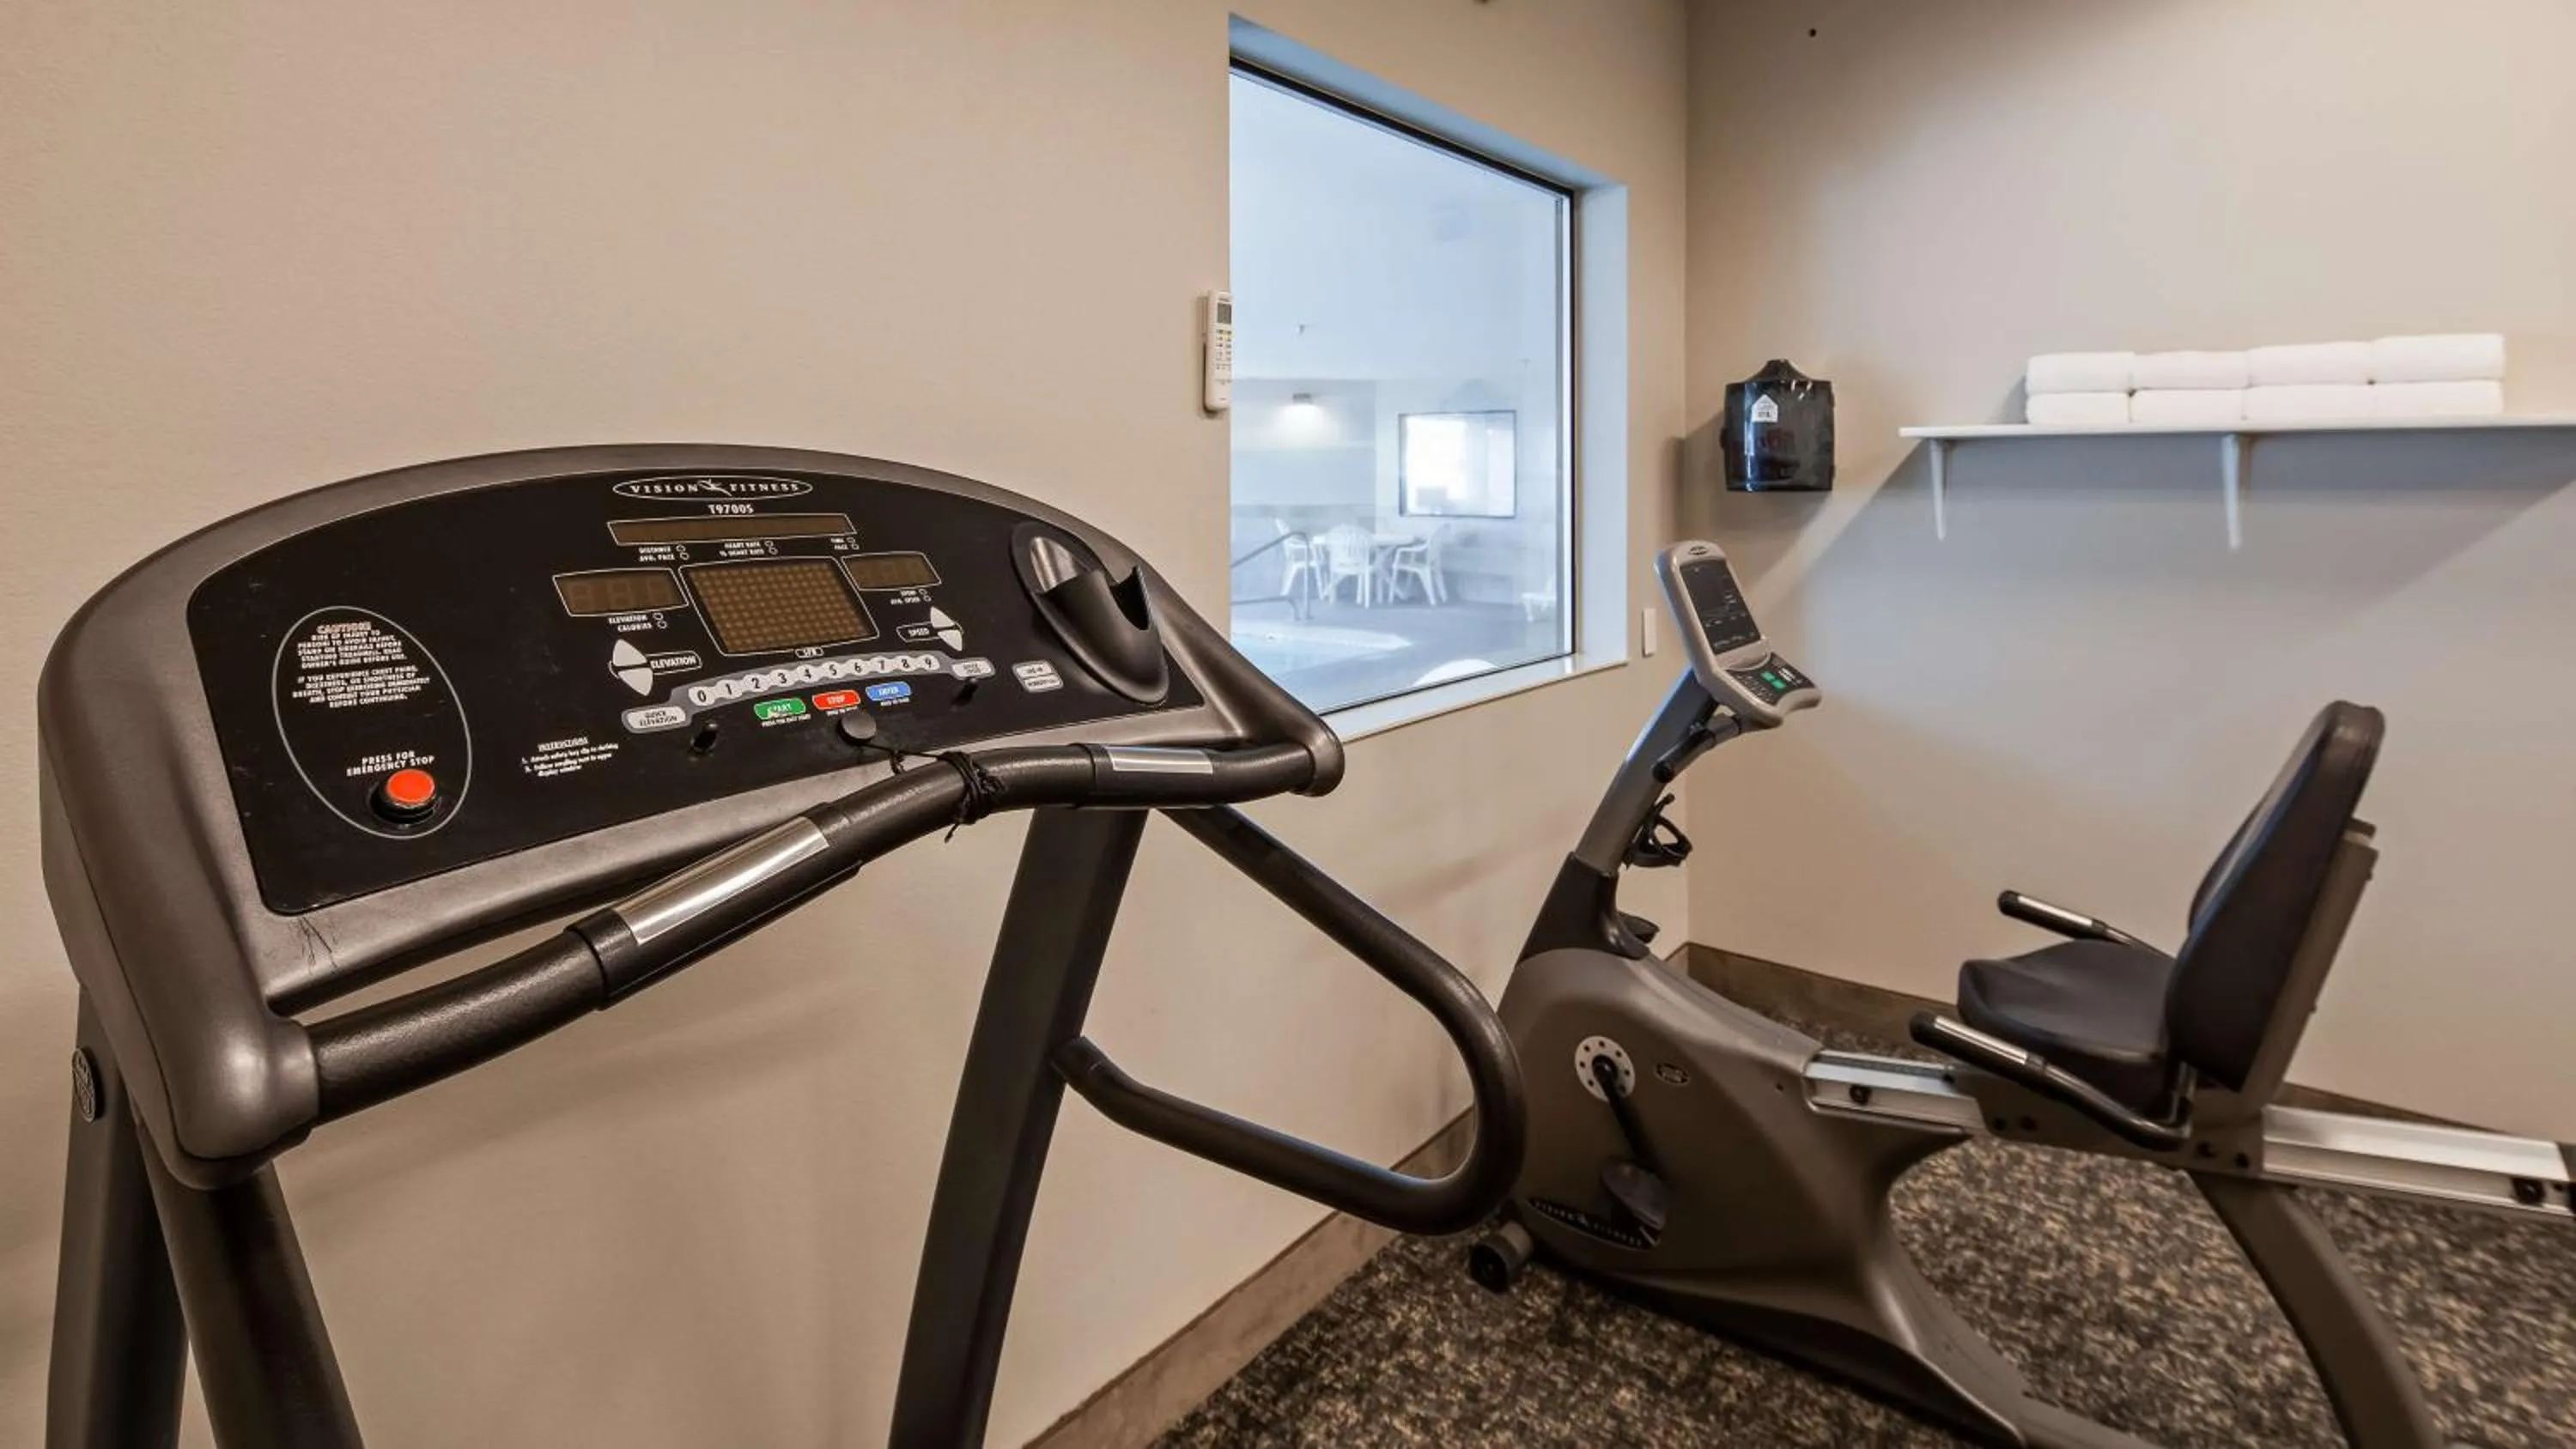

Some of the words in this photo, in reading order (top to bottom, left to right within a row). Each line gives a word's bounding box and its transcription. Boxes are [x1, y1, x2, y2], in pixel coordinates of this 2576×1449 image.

[629, 482, 698, 494] VISION
[730, 482, 799, 492] FITNESS
[908, 627, 930, 637] SPEED
[650, 655, 697, 670] ELEVATION
[697, 690, 707, 702] 0
[726, 683, 732, 694] 1
[751, 677, 760, 688] 2
[780, 672, 787, 683] 3
[804, 669, 811, 679] 4
[829, 664, 837, 676] 5
[854, 663, 862, 673] 6
[878, 660, 885, 670] 7
[902, 658, 909, 668] 8
[925, 658, 932, 667] 9
[361, 753, 392, 765] PRESS
[396, 749, 415, 760] FOR
[346, 760, 406, 777] EMERGENCY
[410, 755, 434, 767] STOP
